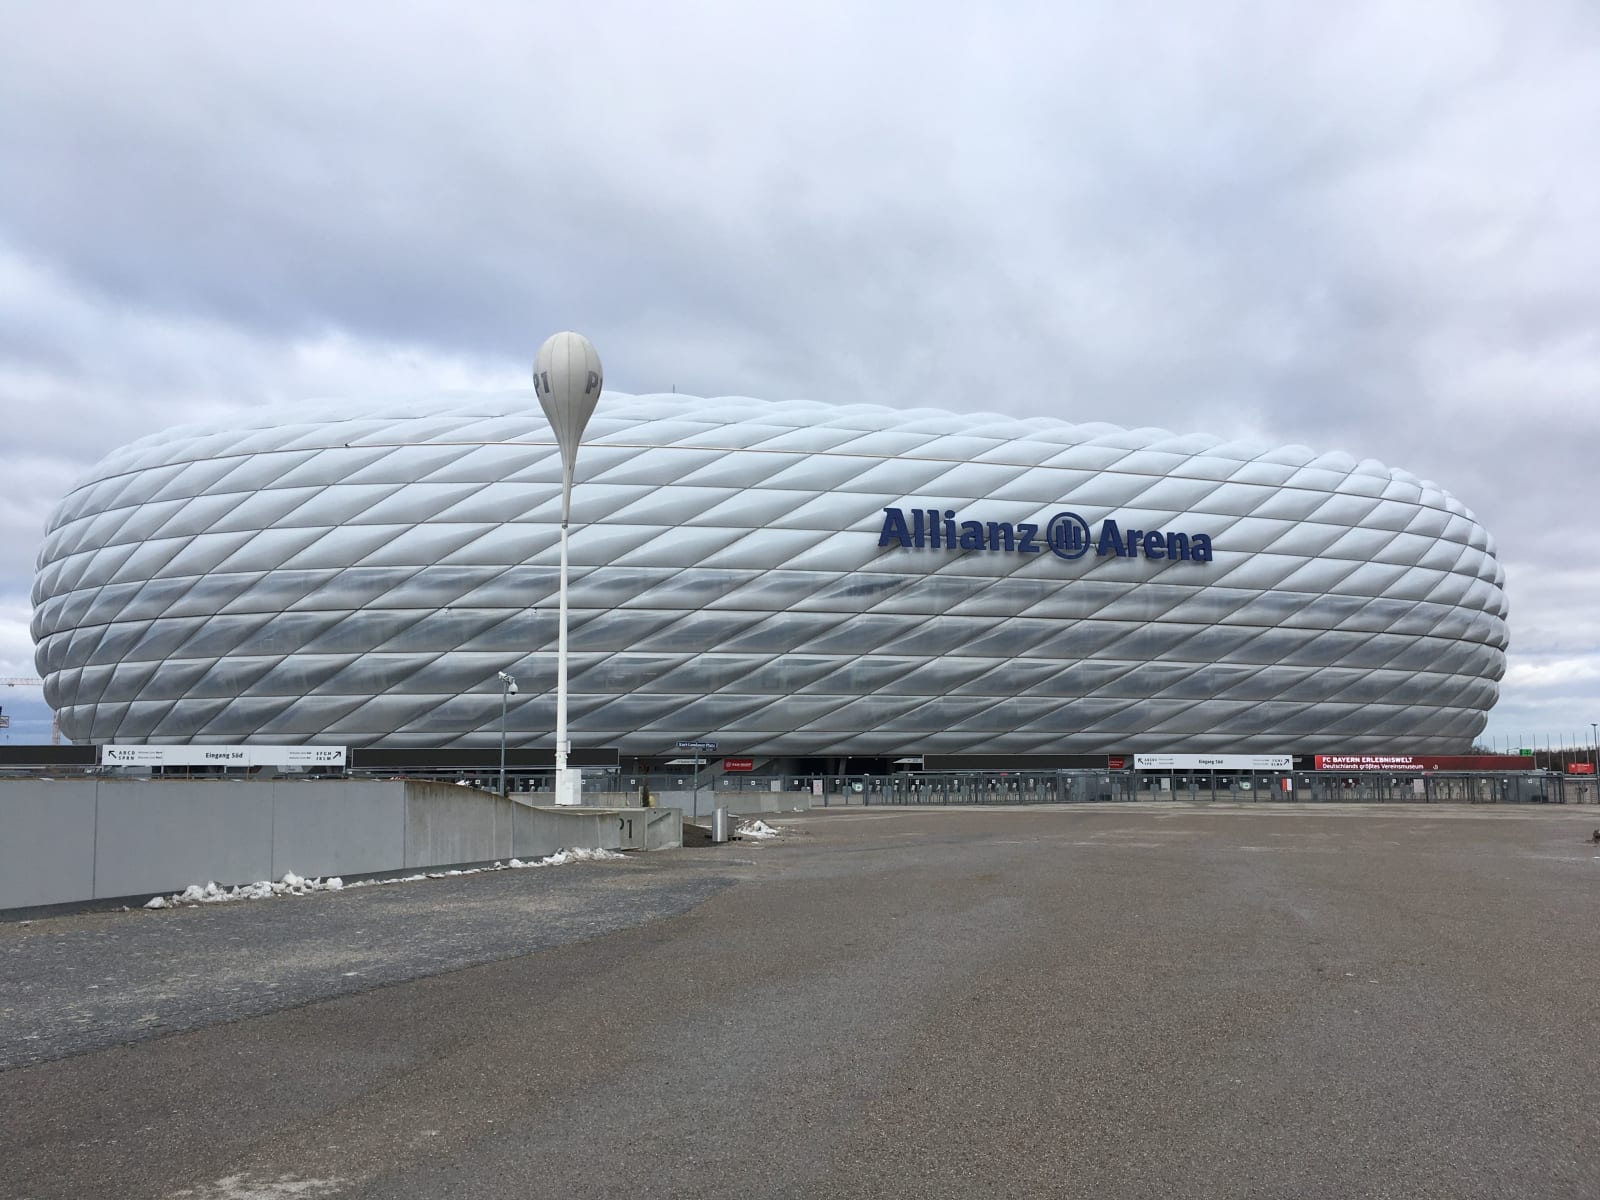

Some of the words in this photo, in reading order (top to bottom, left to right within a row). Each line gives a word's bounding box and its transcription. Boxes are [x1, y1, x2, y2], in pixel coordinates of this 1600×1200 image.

[878, 507, 1040, 553] Allianz
[1096, 518, 1213, 562] Arena
[205, 752, 230, 760] Eingang
